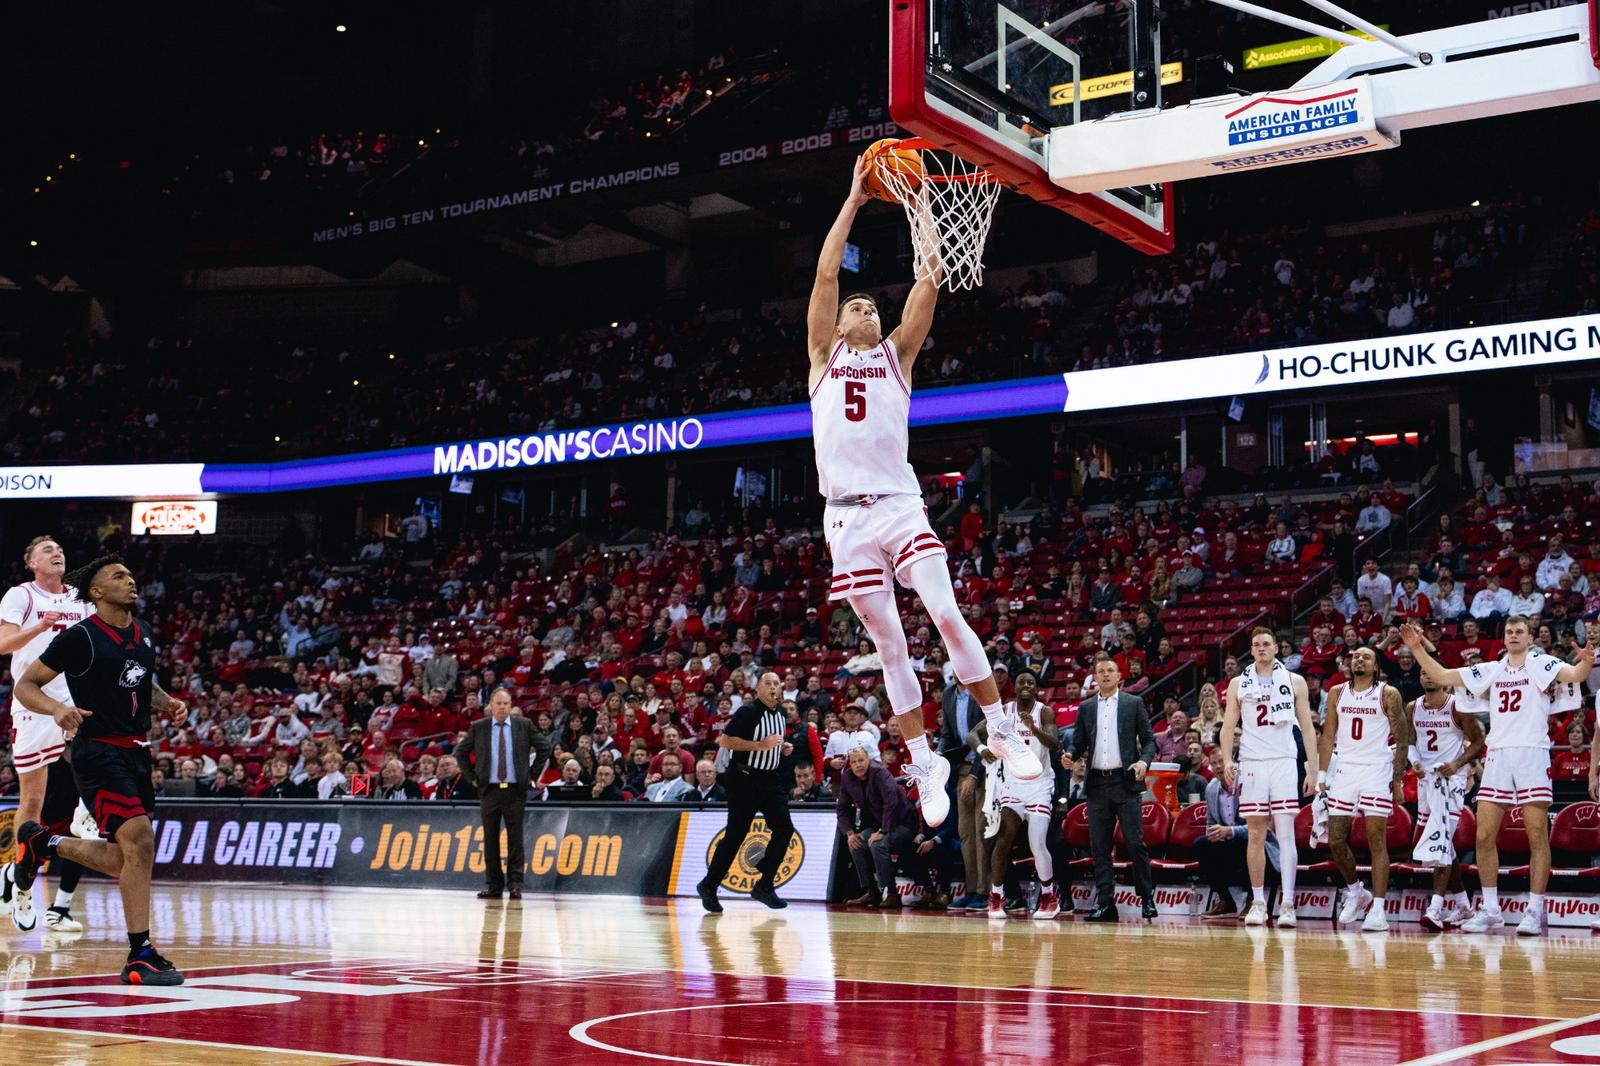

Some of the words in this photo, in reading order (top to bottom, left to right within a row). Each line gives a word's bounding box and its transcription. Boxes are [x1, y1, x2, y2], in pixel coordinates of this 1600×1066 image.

[1228, 108, 1300, 133] AMERICAN
[1306, 97, 1356, 119] FAMILY
[1238, 114, 1349, 142] INSURANCE
[719, 145, 767, 166] 2004
[781, 133, 832, 154] 2008
[848, 122, 897, 142] 2015
[313, 223, 362, 243] MEN'S
[369, 217, 396, 232] BIG
[402, 210, 434, 226] TEN
[440, 184, 563, 218] TOURNAMENT
[569, 162, 680, 194] CHAMPIONS
[1279, 342, 1437, 380] HO-CHUNK
[1445, 328, 1577, 362] GAMING
[845, 381, 866, 422] 5
[0, 475, 52, 490] ISON
[1495, 679, 1529, 688] WISCONSIN
[1341, 706, 1377, 715] WISCONSIN
[1498, 689, 1522, 713] 32
[1351, 717, 1364, 740] 0
[1415, 720, 1450, 728] WISCONSIN
[1426, 730, 1438, 751] 2
[182, 821, 209, 865] A
[213, 820, 342, 868] CAREER
